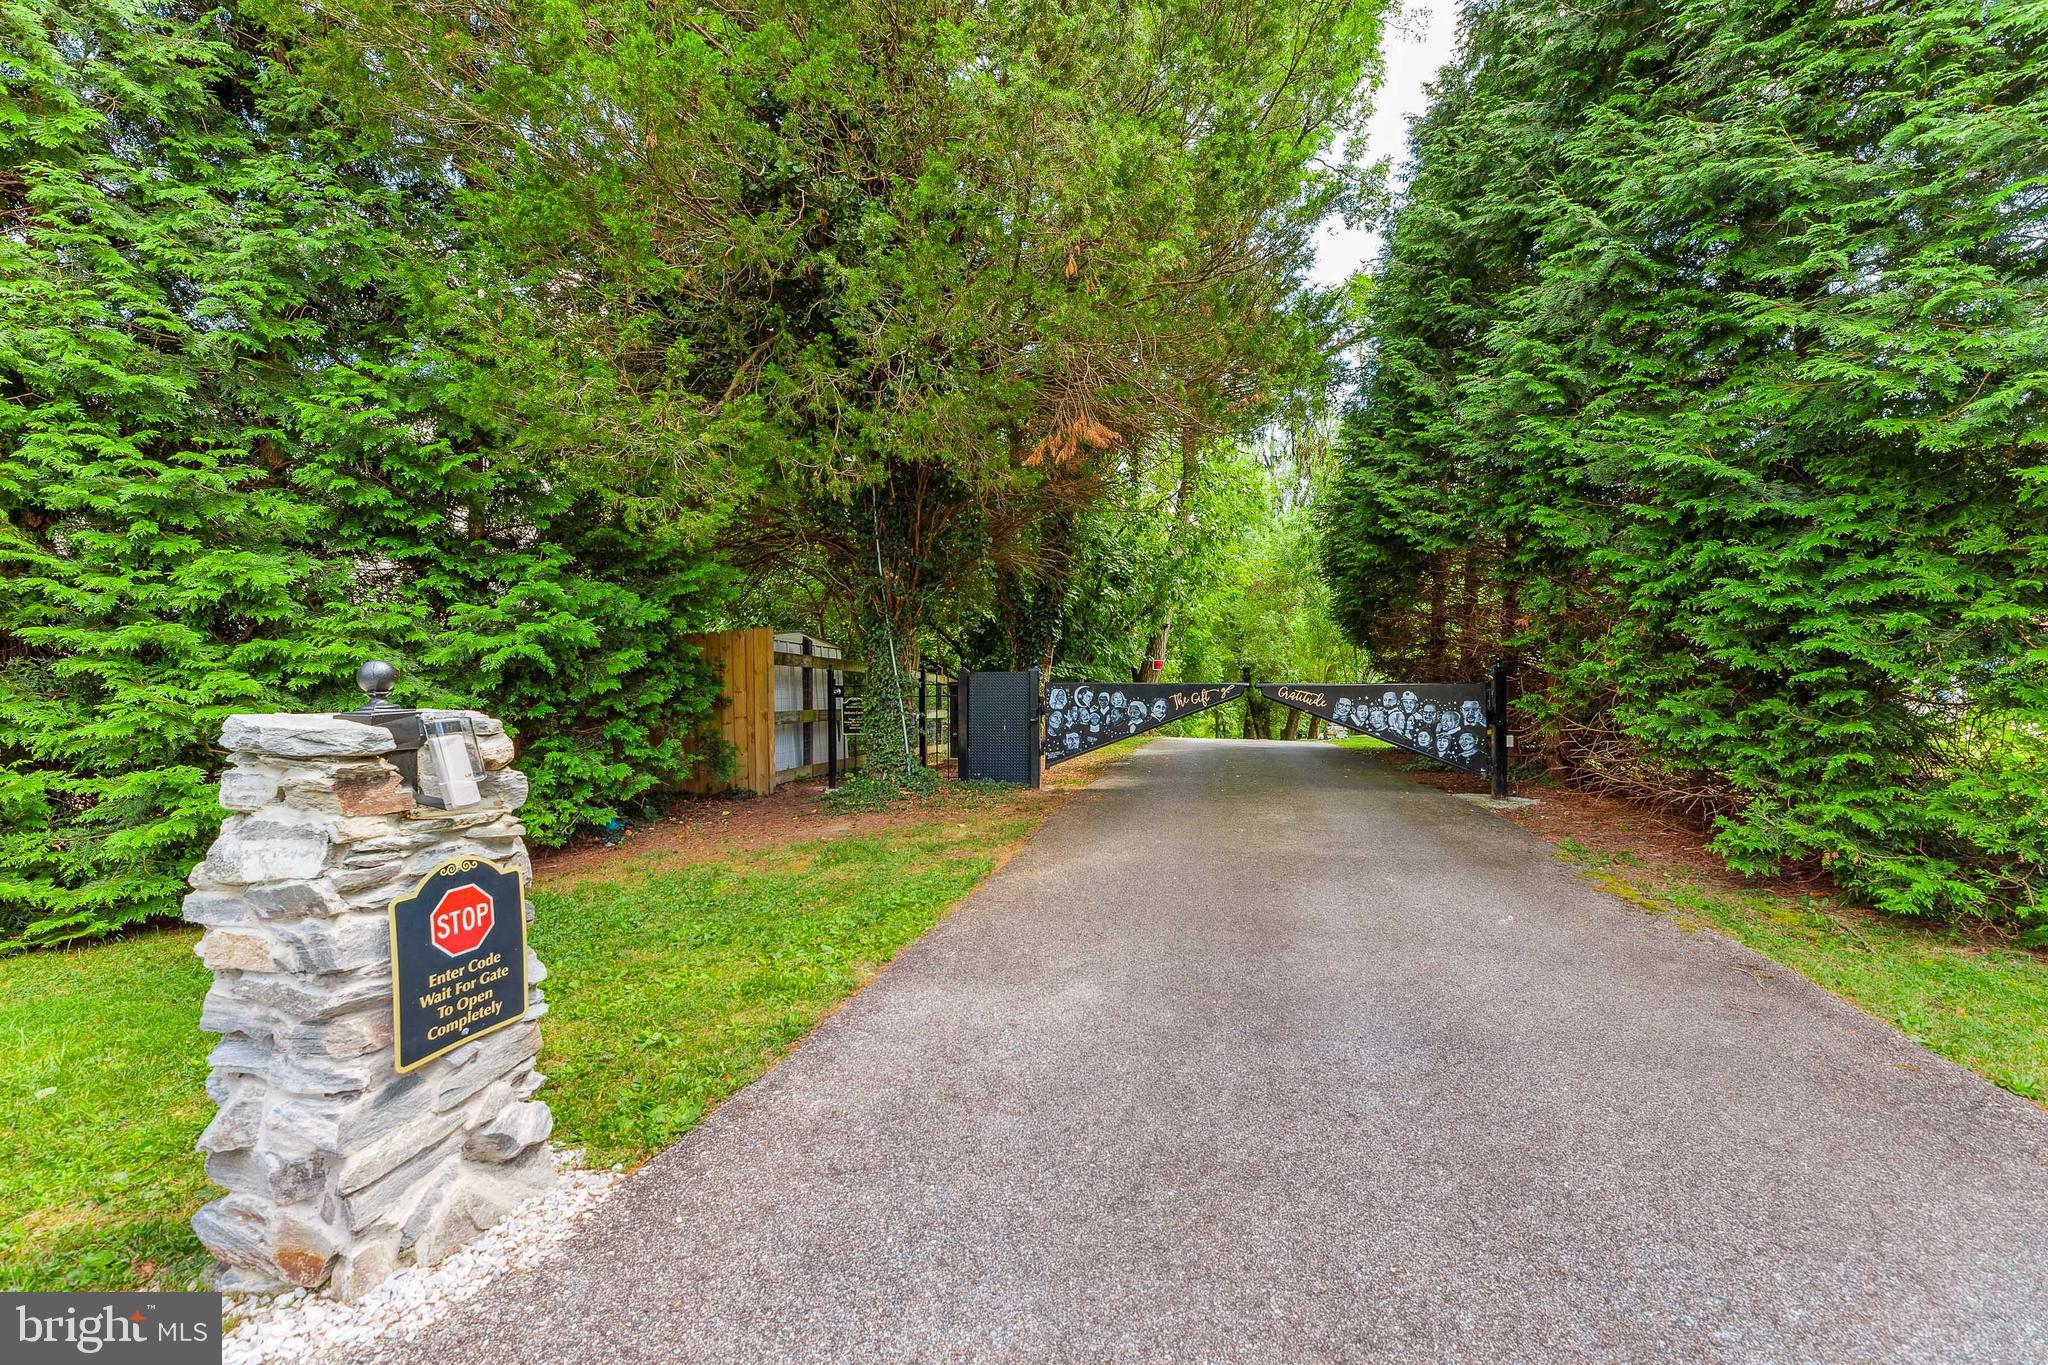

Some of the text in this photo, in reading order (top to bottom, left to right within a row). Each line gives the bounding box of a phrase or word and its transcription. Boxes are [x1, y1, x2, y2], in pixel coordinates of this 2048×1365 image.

[1169, 684, 1235, 710] The Gift of
[1277, 686, 1327, 707] Gratitude
[436, 902, 489, 939] STOP
[419, 966, 509, 1009] Wait For Gate
[428, 952, 501, 988] Enter Code
[427, 1000, 503, 1040] Completely
[437, 989, 493, 1019] To Open
